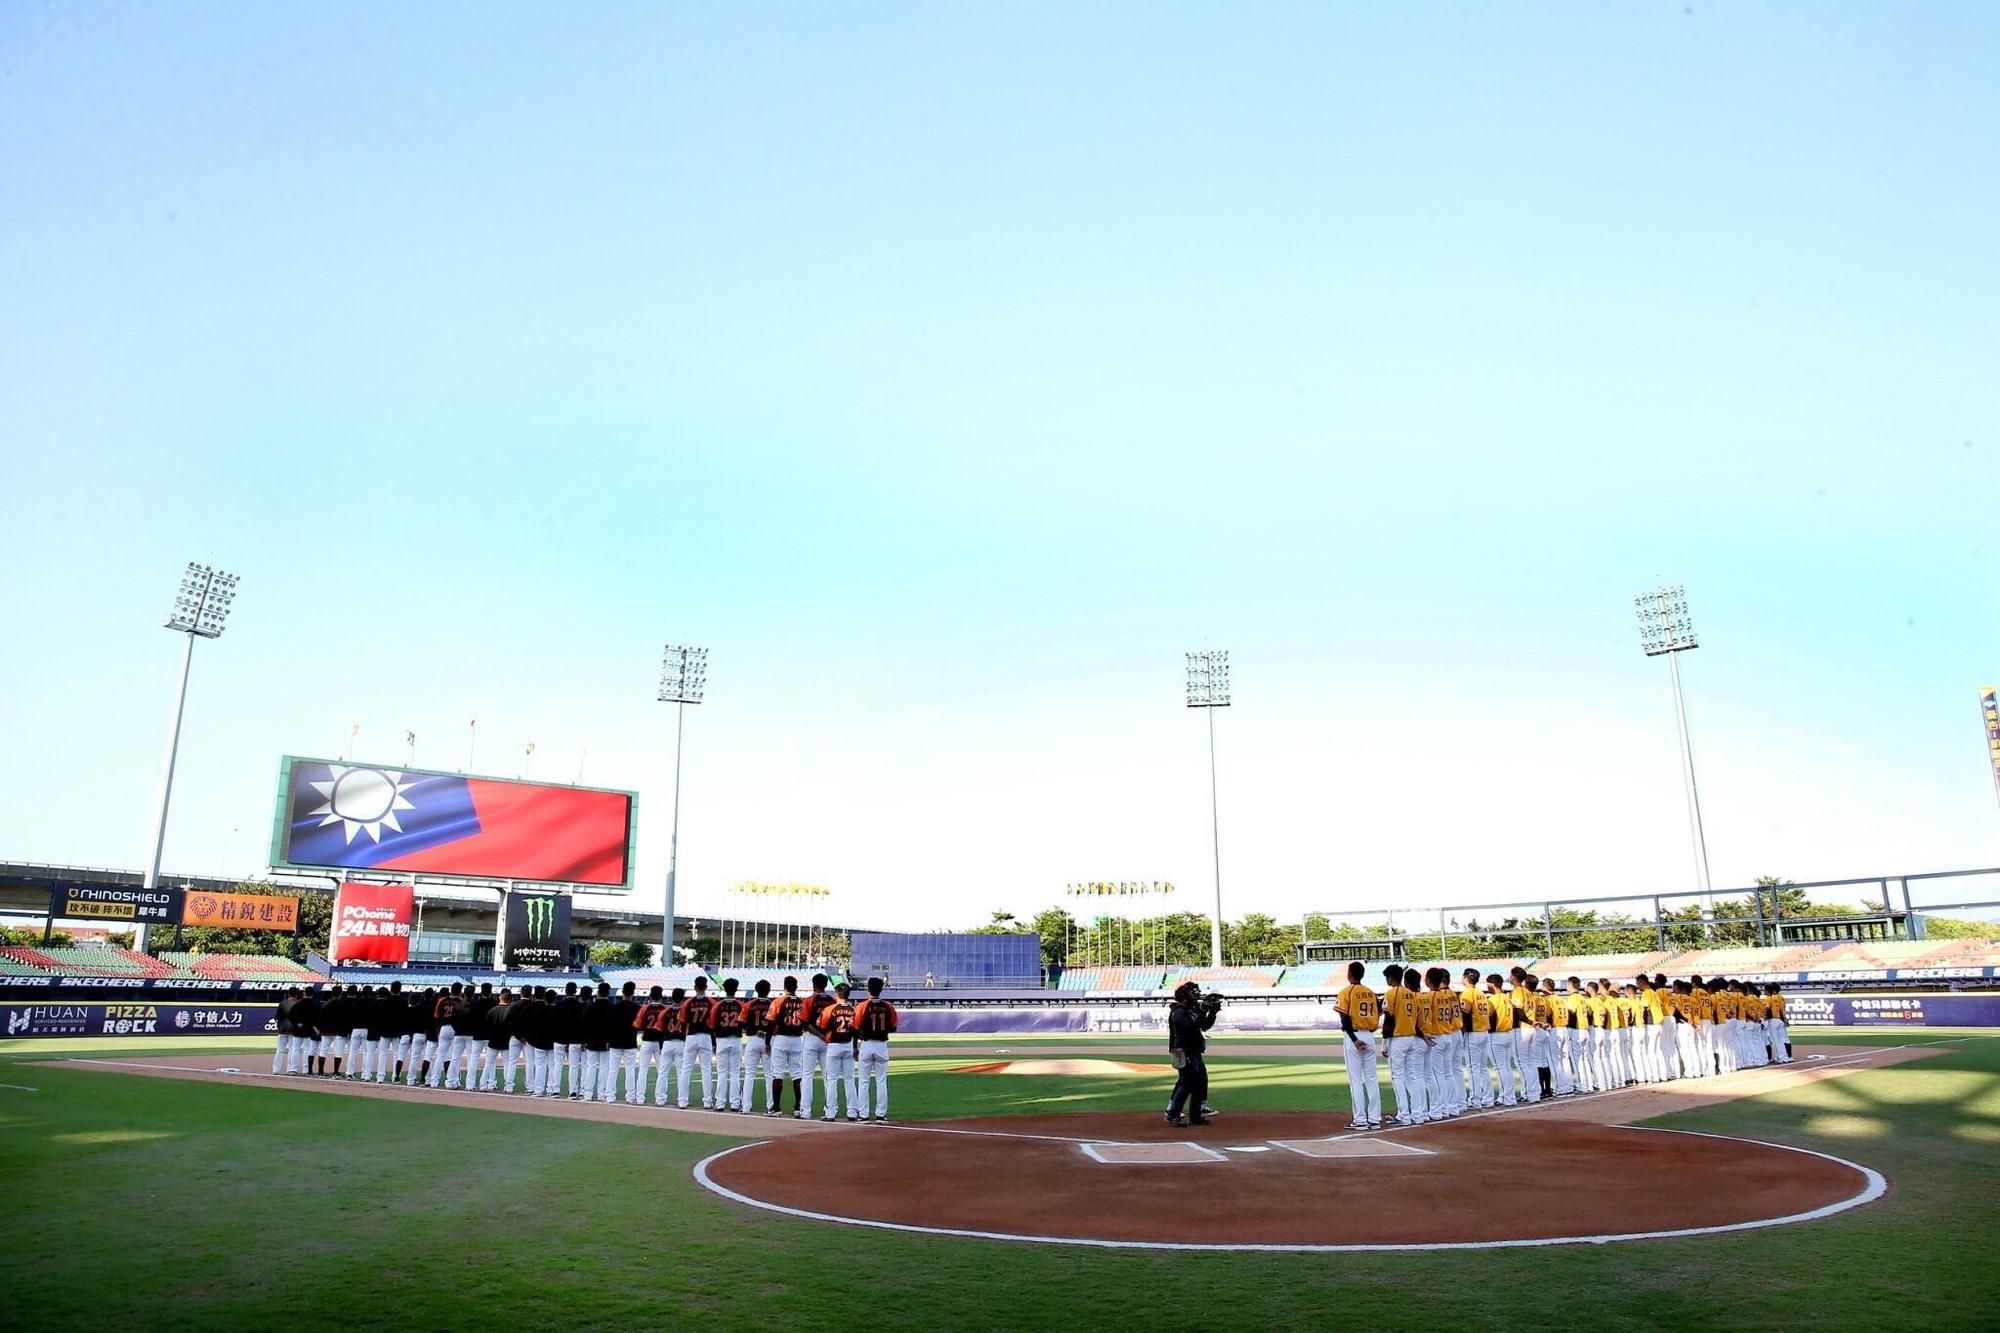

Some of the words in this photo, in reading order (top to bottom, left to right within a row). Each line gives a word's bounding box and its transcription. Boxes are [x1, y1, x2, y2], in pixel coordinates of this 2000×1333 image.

[221, 900, 292, 922] 精銳建設
[343, 906, 396, 920] PChome
[513, 947, 561, 957] MONSTER
[59, 978, 146, 987] SKECHERS
[152, 979, 234, 989] SKECHERS
[34, 1006, 88, 1018] HUAN
[105, 1006, 158, 1018] PIZZA
[193, 1010, 243, 1023] 守信人力
[691, 1007, 709, 1023] 77
[1359, 1002, 1375, 1017] 91
[1406, 1003, 1413, 1018] 9
[720, 1011, 738, 1027] 32
[870, 1013, 886, 1031] 11
